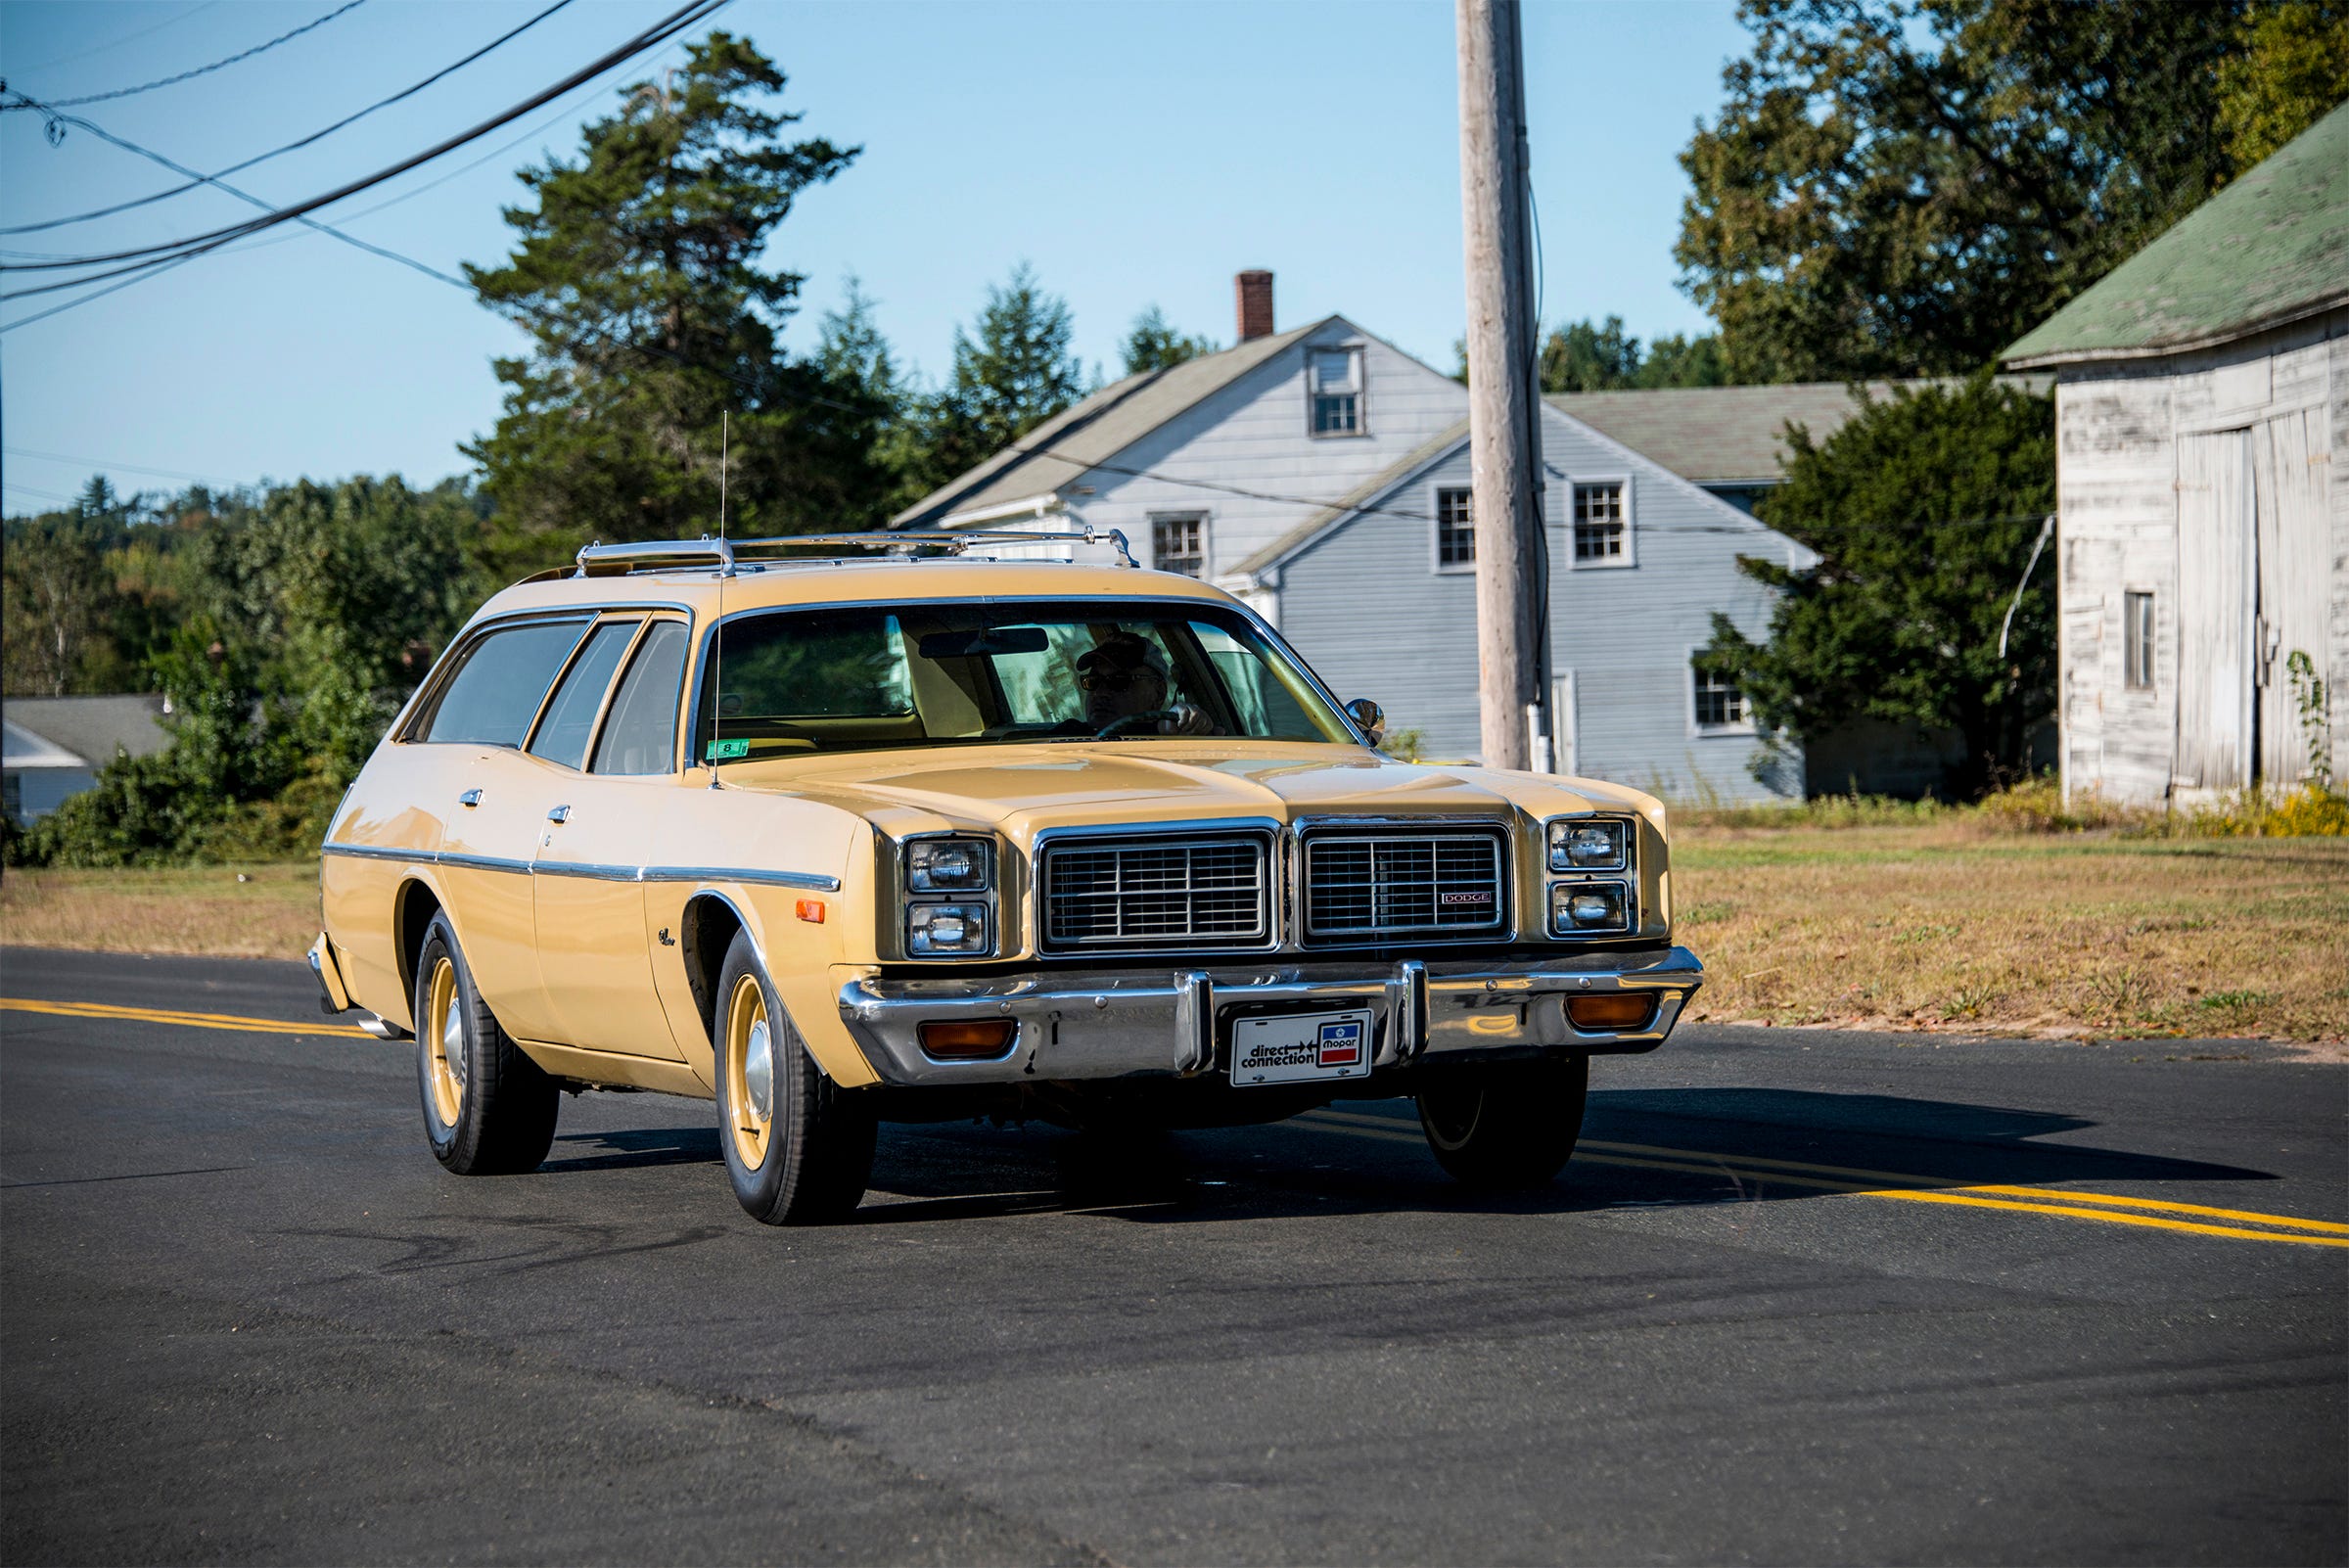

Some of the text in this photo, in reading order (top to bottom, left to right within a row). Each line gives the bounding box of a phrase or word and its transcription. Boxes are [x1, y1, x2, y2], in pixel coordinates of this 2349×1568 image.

[723, 743, 732, 753] 8
[1445, 893, 1490, 902] DODGE
[1250, 1043, 1289, 1058] direct
[1241, 1052, 1314, 1069] connection
